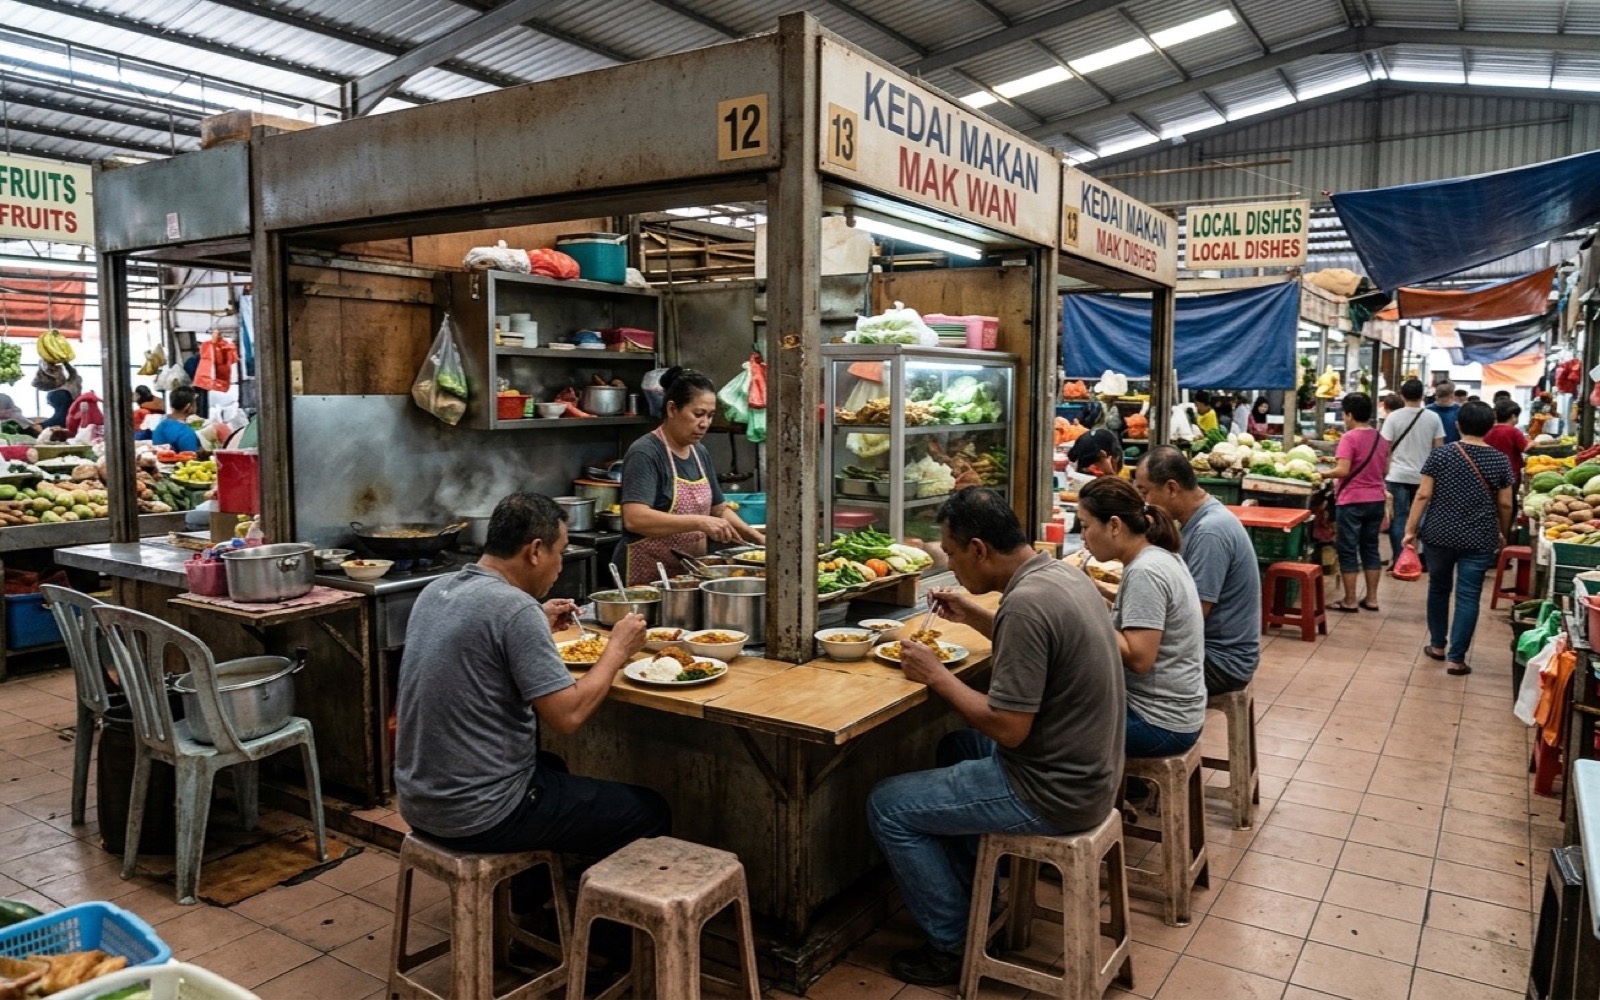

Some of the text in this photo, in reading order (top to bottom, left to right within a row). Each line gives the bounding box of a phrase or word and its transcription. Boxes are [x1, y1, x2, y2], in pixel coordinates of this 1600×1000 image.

[724, 104, 761, 151] 12
[832, 114, 853, 161] 13
[864, 71, 1039, 194] KEDAI MAKAN
[0, 165, 76, 204] FRUITS
[899, 145, 1017, 227] MAK WAN
[0, 203, 77, 233] FRUITS
[1081, 180, 1167, 249] KEDAI MAKAN
[1193, 207, 1302, 238] LOCAL DISHES
[1096, 227, 1157, 273] MAK DISHES
[1192, 239, 1300, 261] LOCAL DISHES
